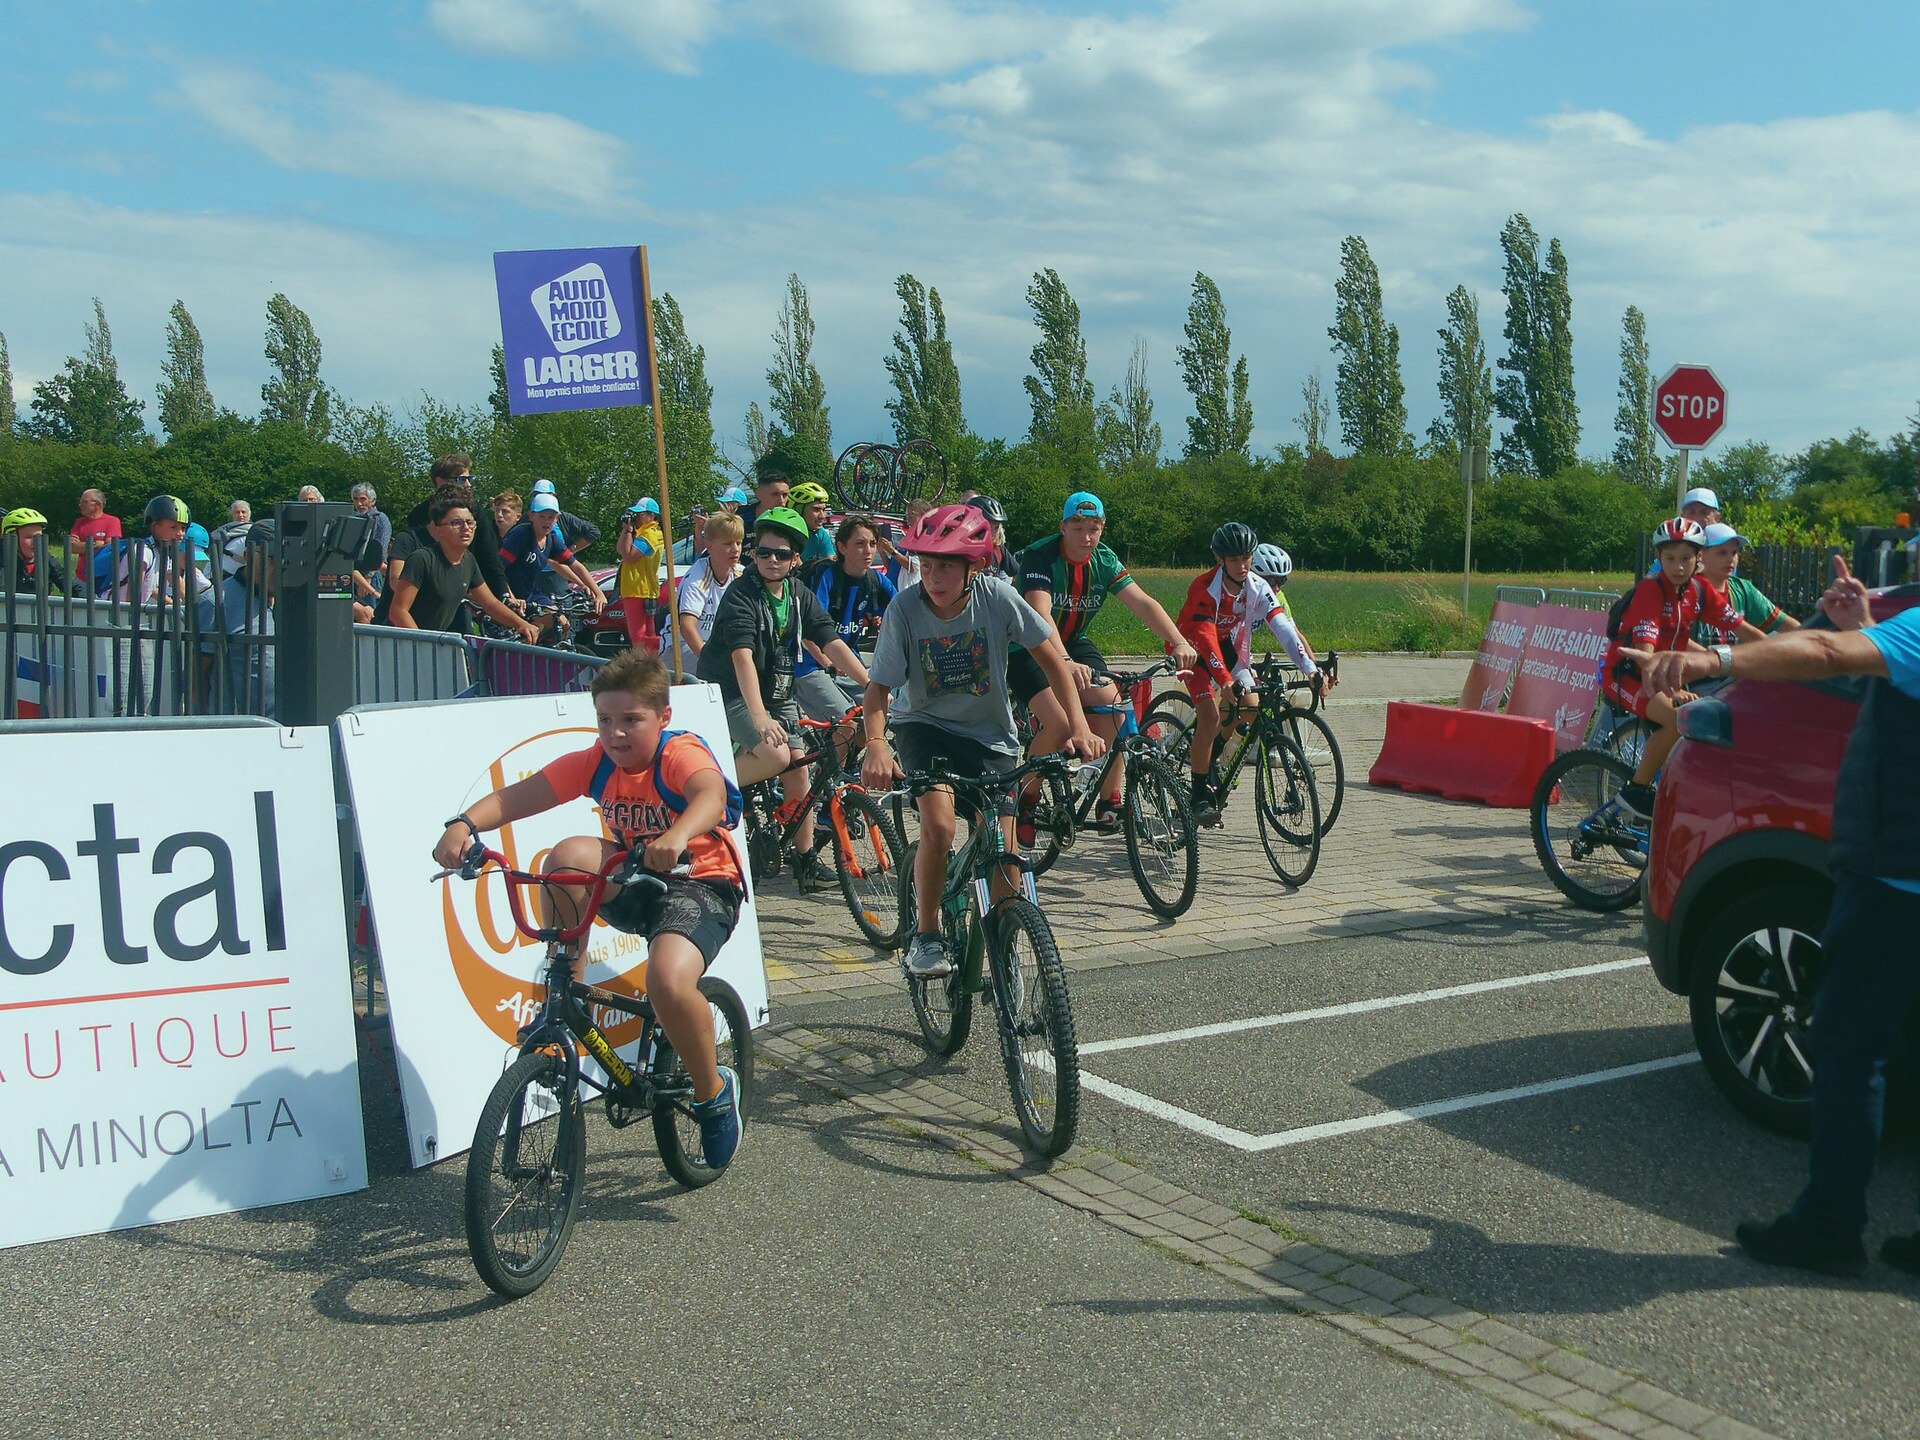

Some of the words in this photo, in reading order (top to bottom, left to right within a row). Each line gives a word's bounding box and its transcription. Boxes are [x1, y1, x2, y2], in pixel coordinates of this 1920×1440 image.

[549, 278, 605, 301] AUTO
[550, 300, 607, 322] MOTO
[552, 320, 609, 342] ECOLE
[524, 350, 639, 386] LARGER
[527, 388, 544, 399] Mon
[545, 385, 571, 399] permis
[572, 385, 582, 395] en
[582, 382, 601, 394] toute
[602, 380, 636, 392] confiance
[1661, 394, 1720, 420] STOP
[525, 551, 537, 564] 19
[1520, 658, 1559, 680] partenaire
[1557, 663, 1569, 684] du
[1569, 671, 1597, 692] sport
[611, 934, 641, 958] 1908
[0, 1006, 297, 1083] UTIQUE
[36, 1096, 304, 1173] MINOLTA
